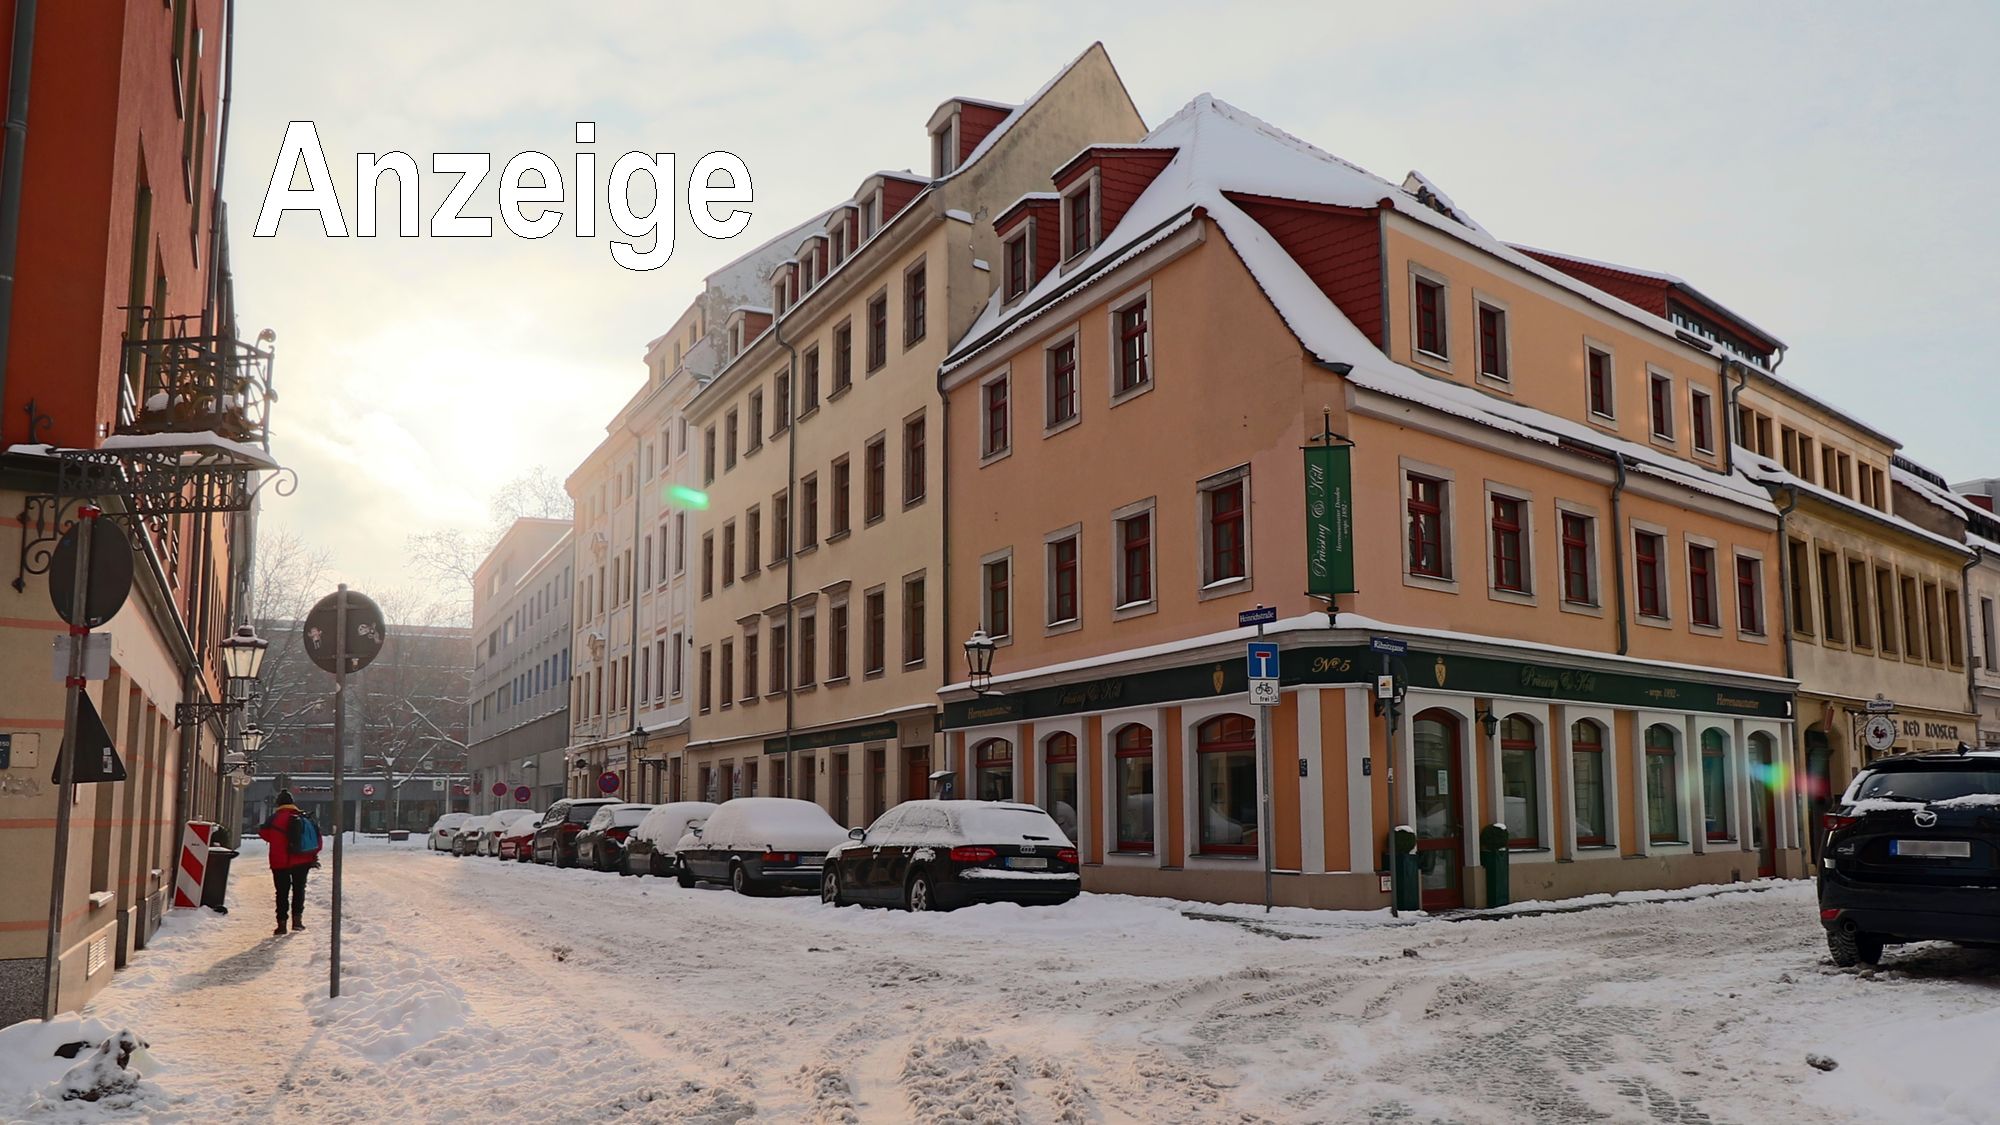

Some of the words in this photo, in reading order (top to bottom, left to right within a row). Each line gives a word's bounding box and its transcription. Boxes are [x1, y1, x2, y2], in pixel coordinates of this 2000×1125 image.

[1309, 463, 1326, 497] Köll
[1340, 659, 1351, 672] 5
[1903, 719, 1920, 737] RED
[1924, 722, 1959, 740] ROOSTER
